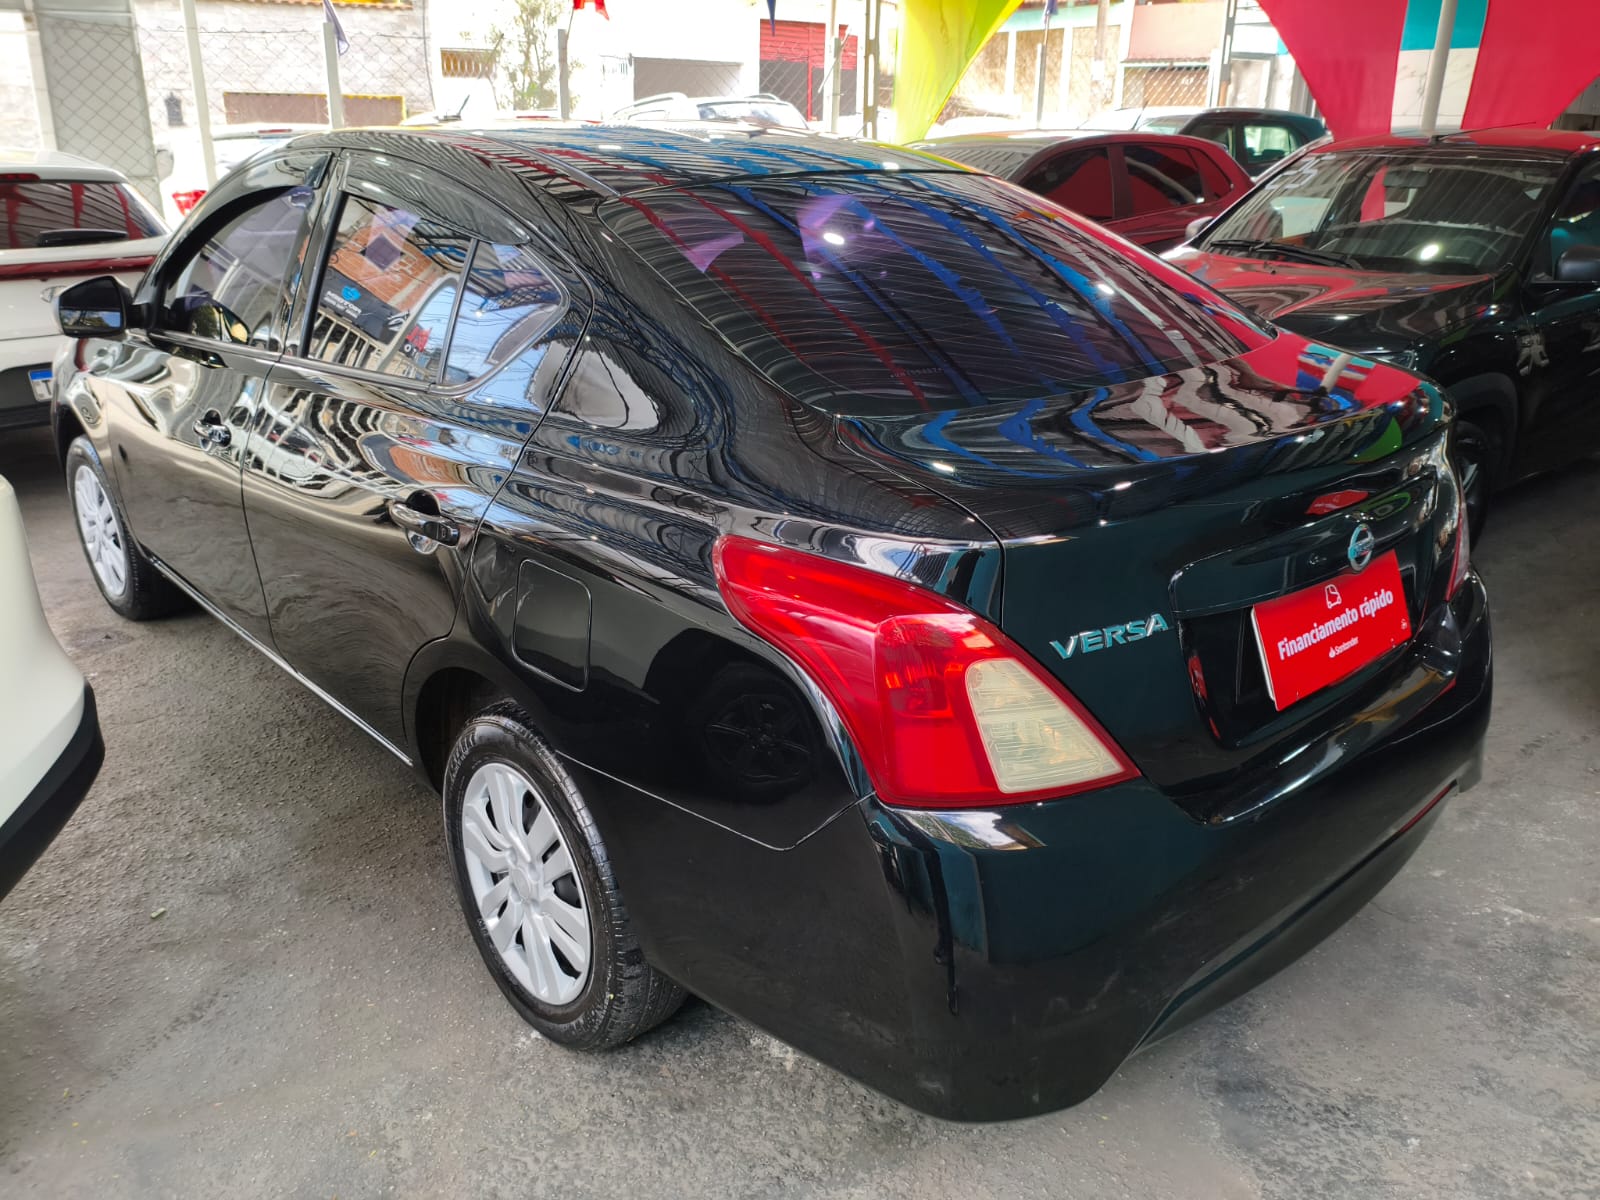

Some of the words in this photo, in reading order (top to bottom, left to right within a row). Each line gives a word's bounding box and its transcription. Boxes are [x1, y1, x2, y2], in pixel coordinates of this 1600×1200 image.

[1049, 612, 1169, 660] VERSA
[1276, 608, 1359, 661] Financiamento
[1359, 588, 1394, 619] rápido
[1334, 636, 1360, 656] Santander
